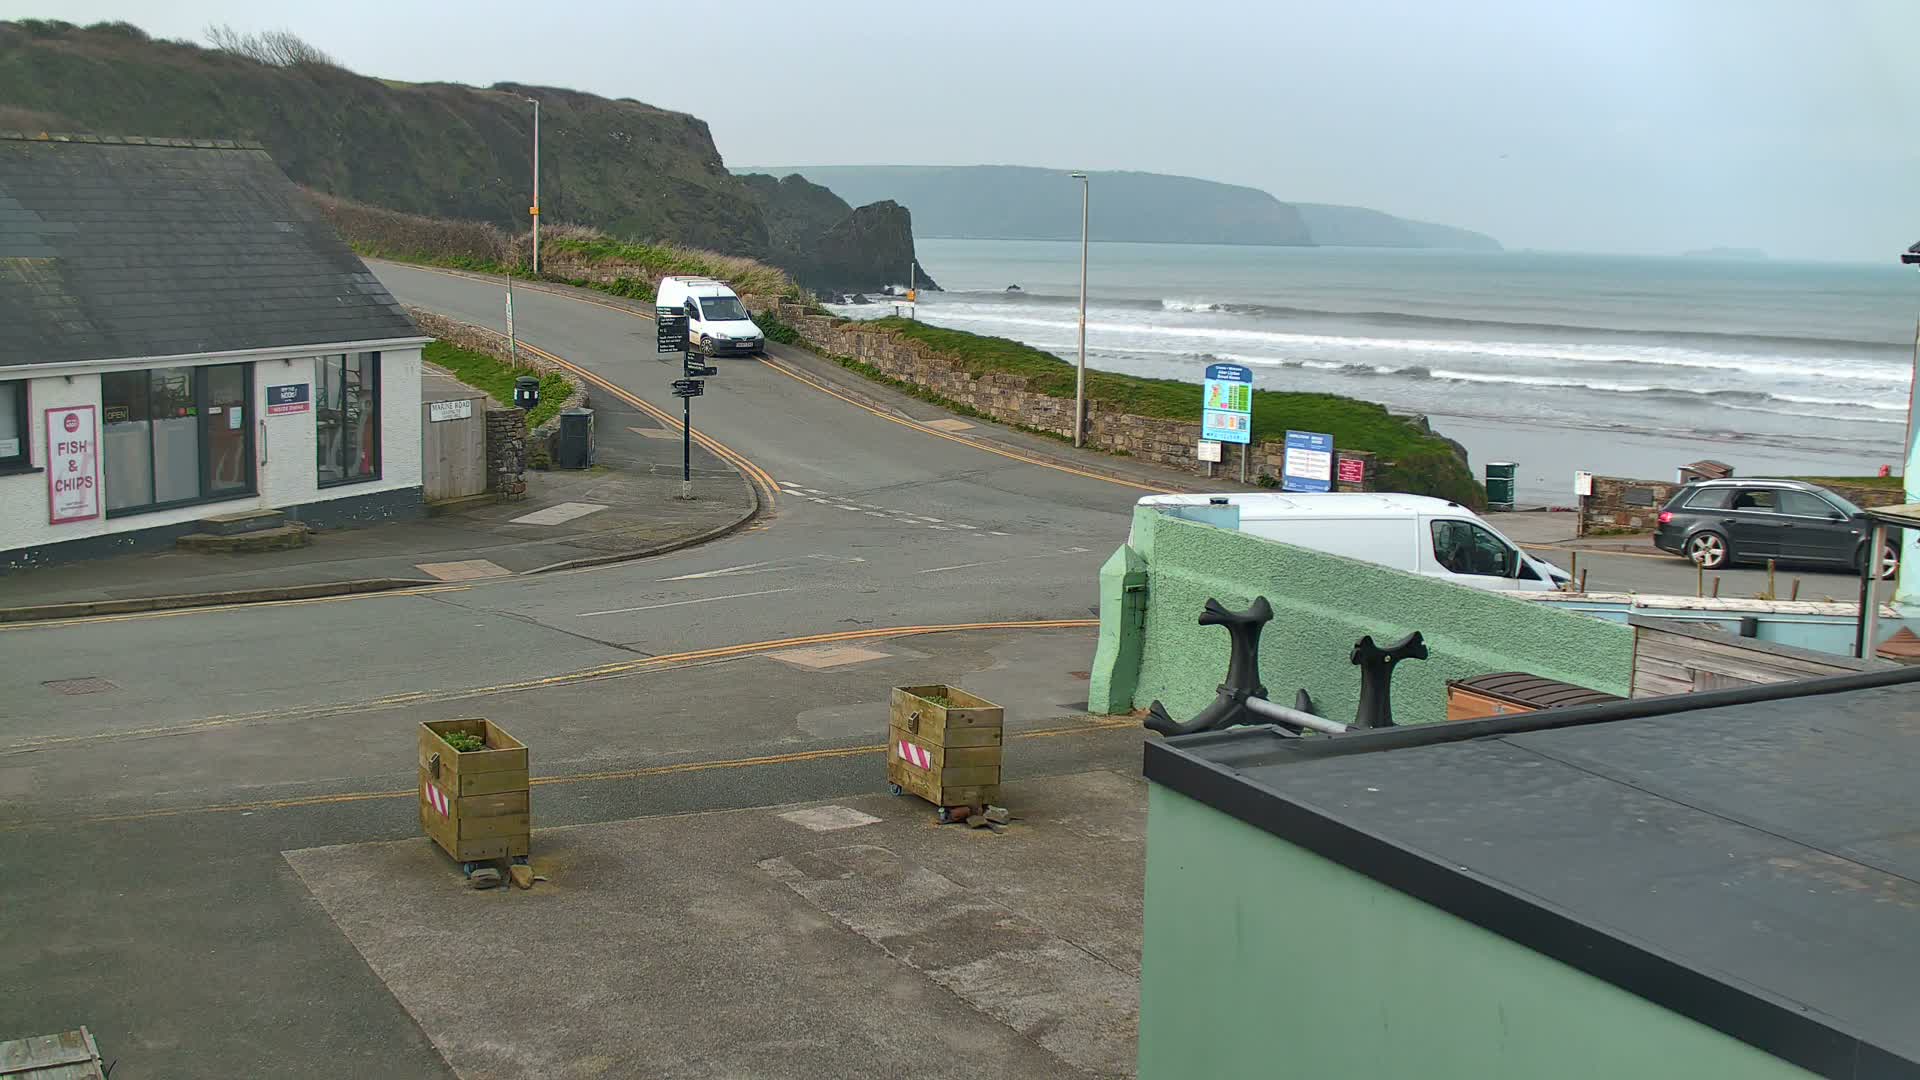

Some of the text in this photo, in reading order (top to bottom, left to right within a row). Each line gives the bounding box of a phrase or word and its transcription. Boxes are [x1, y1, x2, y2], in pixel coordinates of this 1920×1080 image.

[432, 400, 470, 411] MARINE ROAD
[107, 410, 126, 420] OPEN
[58, 440, 87, 456] FISH
[68, 459, 78, 472] &
[55, 476, 93, 492] CHIPS
